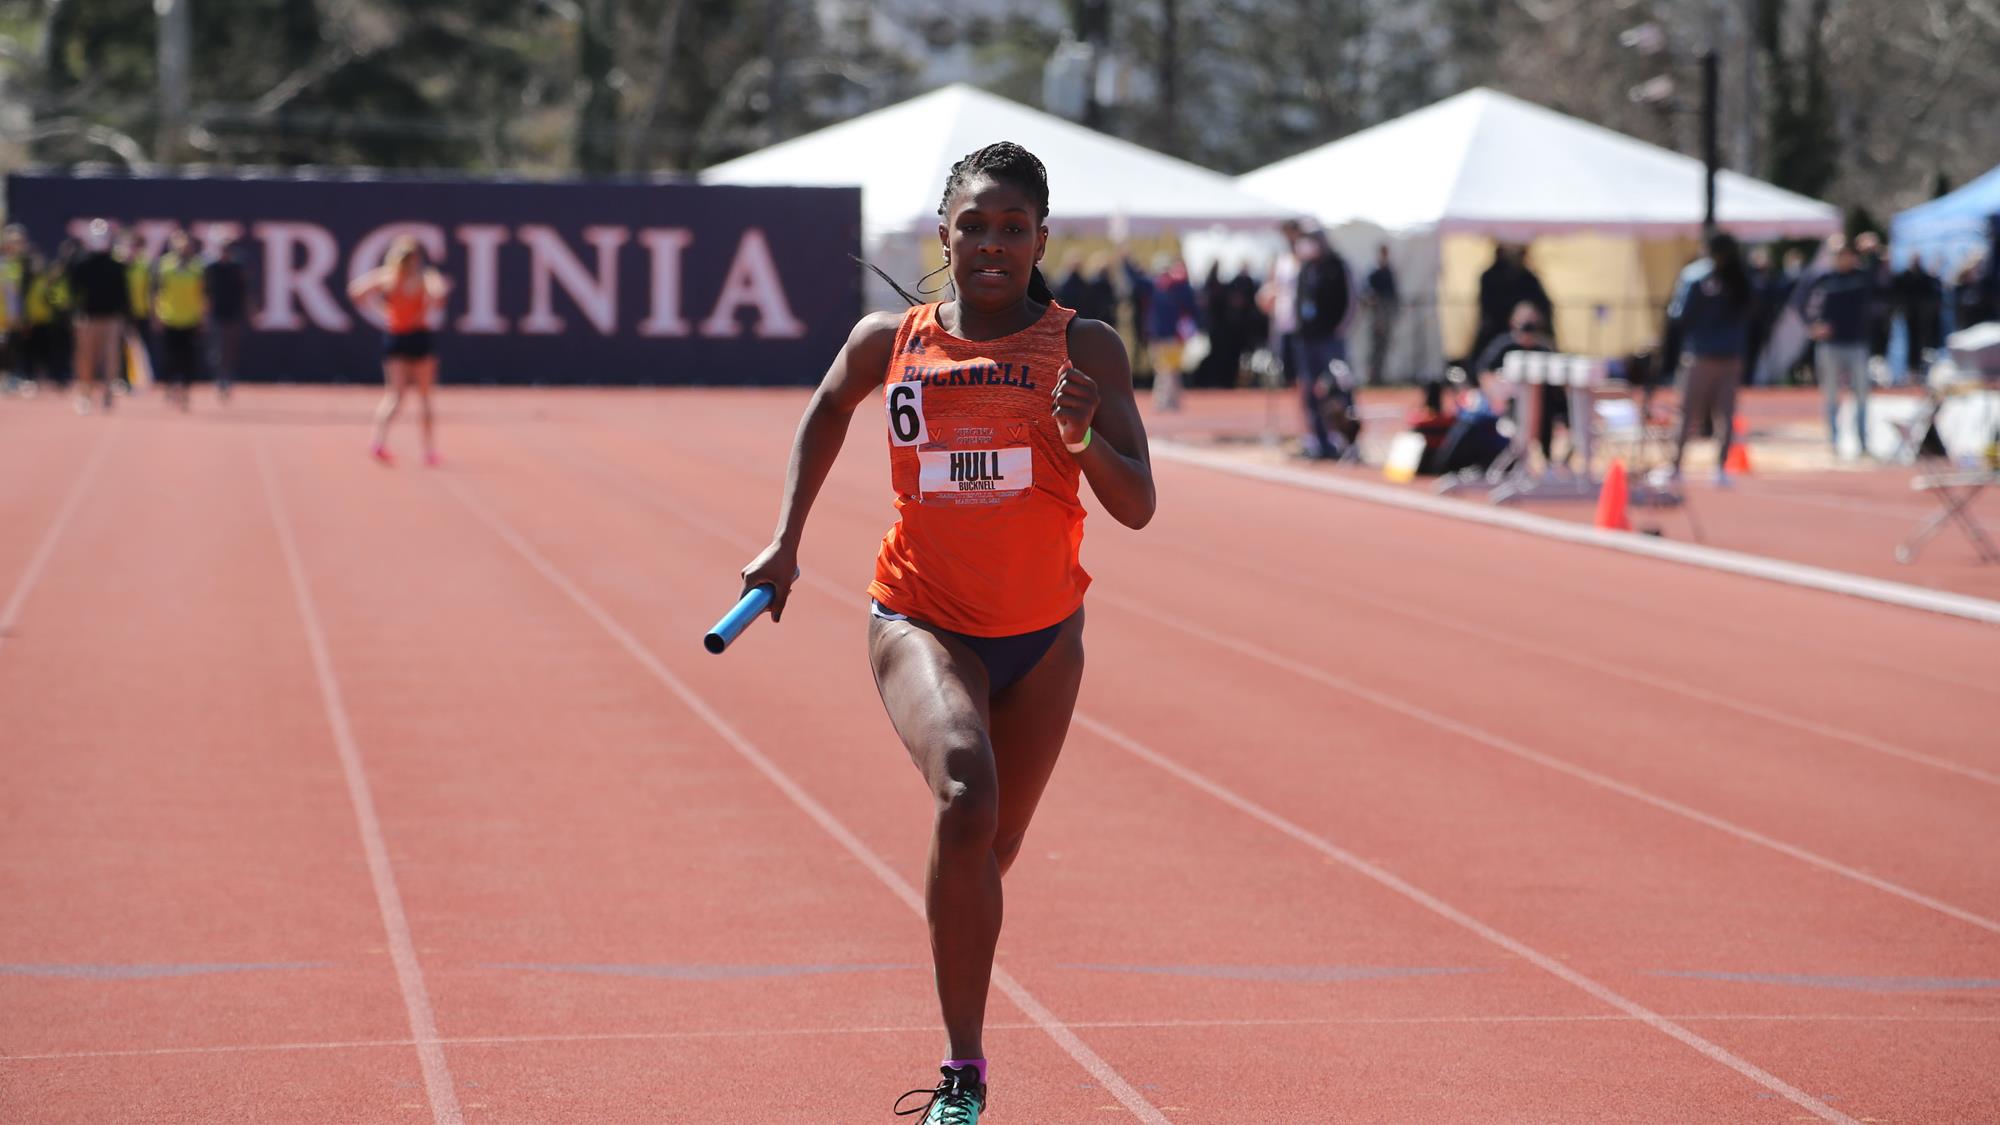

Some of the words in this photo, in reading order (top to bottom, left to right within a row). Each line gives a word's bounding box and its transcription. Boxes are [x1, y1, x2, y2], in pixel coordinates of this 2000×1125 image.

[902, 362, 1035, 389] BUCKNELL
[890, 385, 920, 442] 6
[949, 452, 1004, 481] HULL
[958, 481, 996, 491] BUCKNELL
